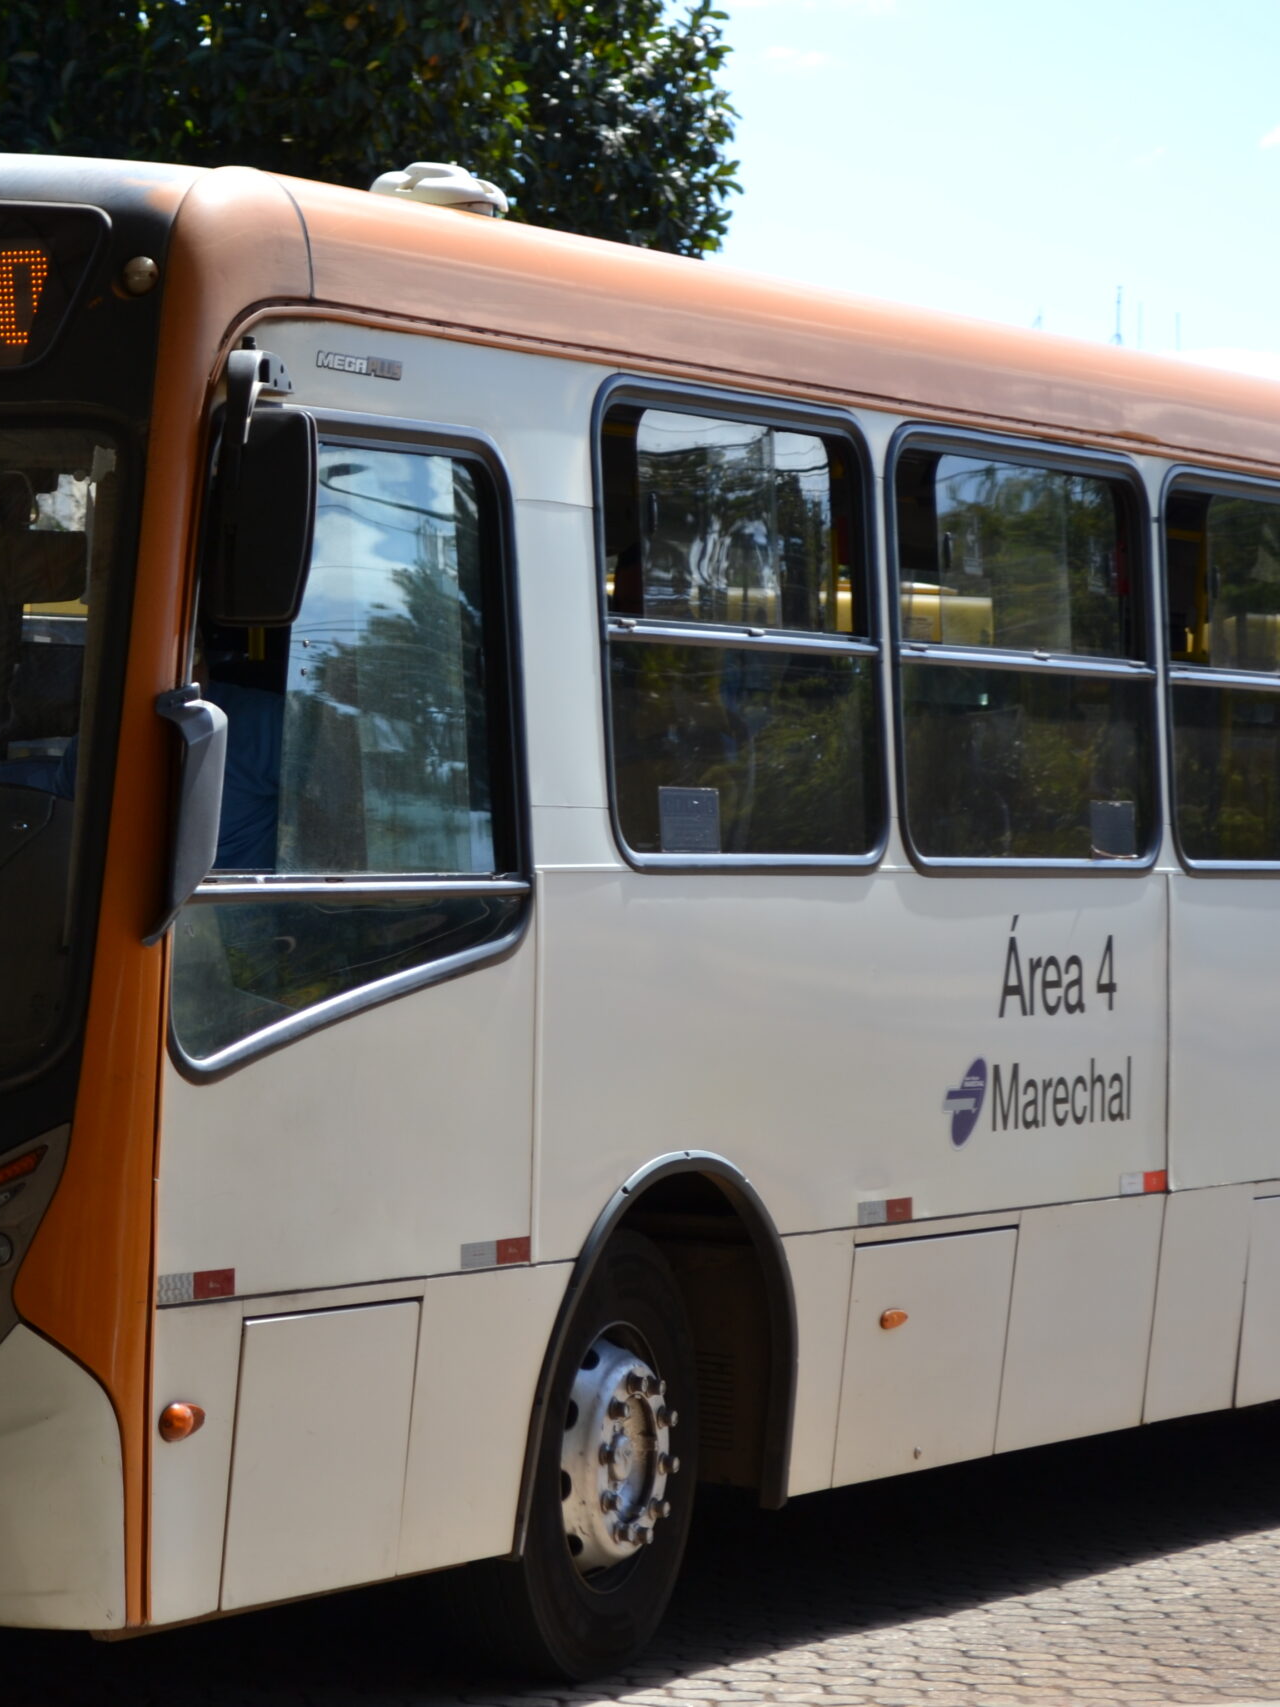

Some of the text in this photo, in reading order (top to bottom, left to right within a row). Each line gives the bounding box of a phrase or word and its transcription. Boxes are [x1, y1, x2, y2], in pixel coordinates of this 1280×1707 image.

[997, 913, 1118, 1019] Área 4
[990, 1054, 1133, 1132] Marechal
